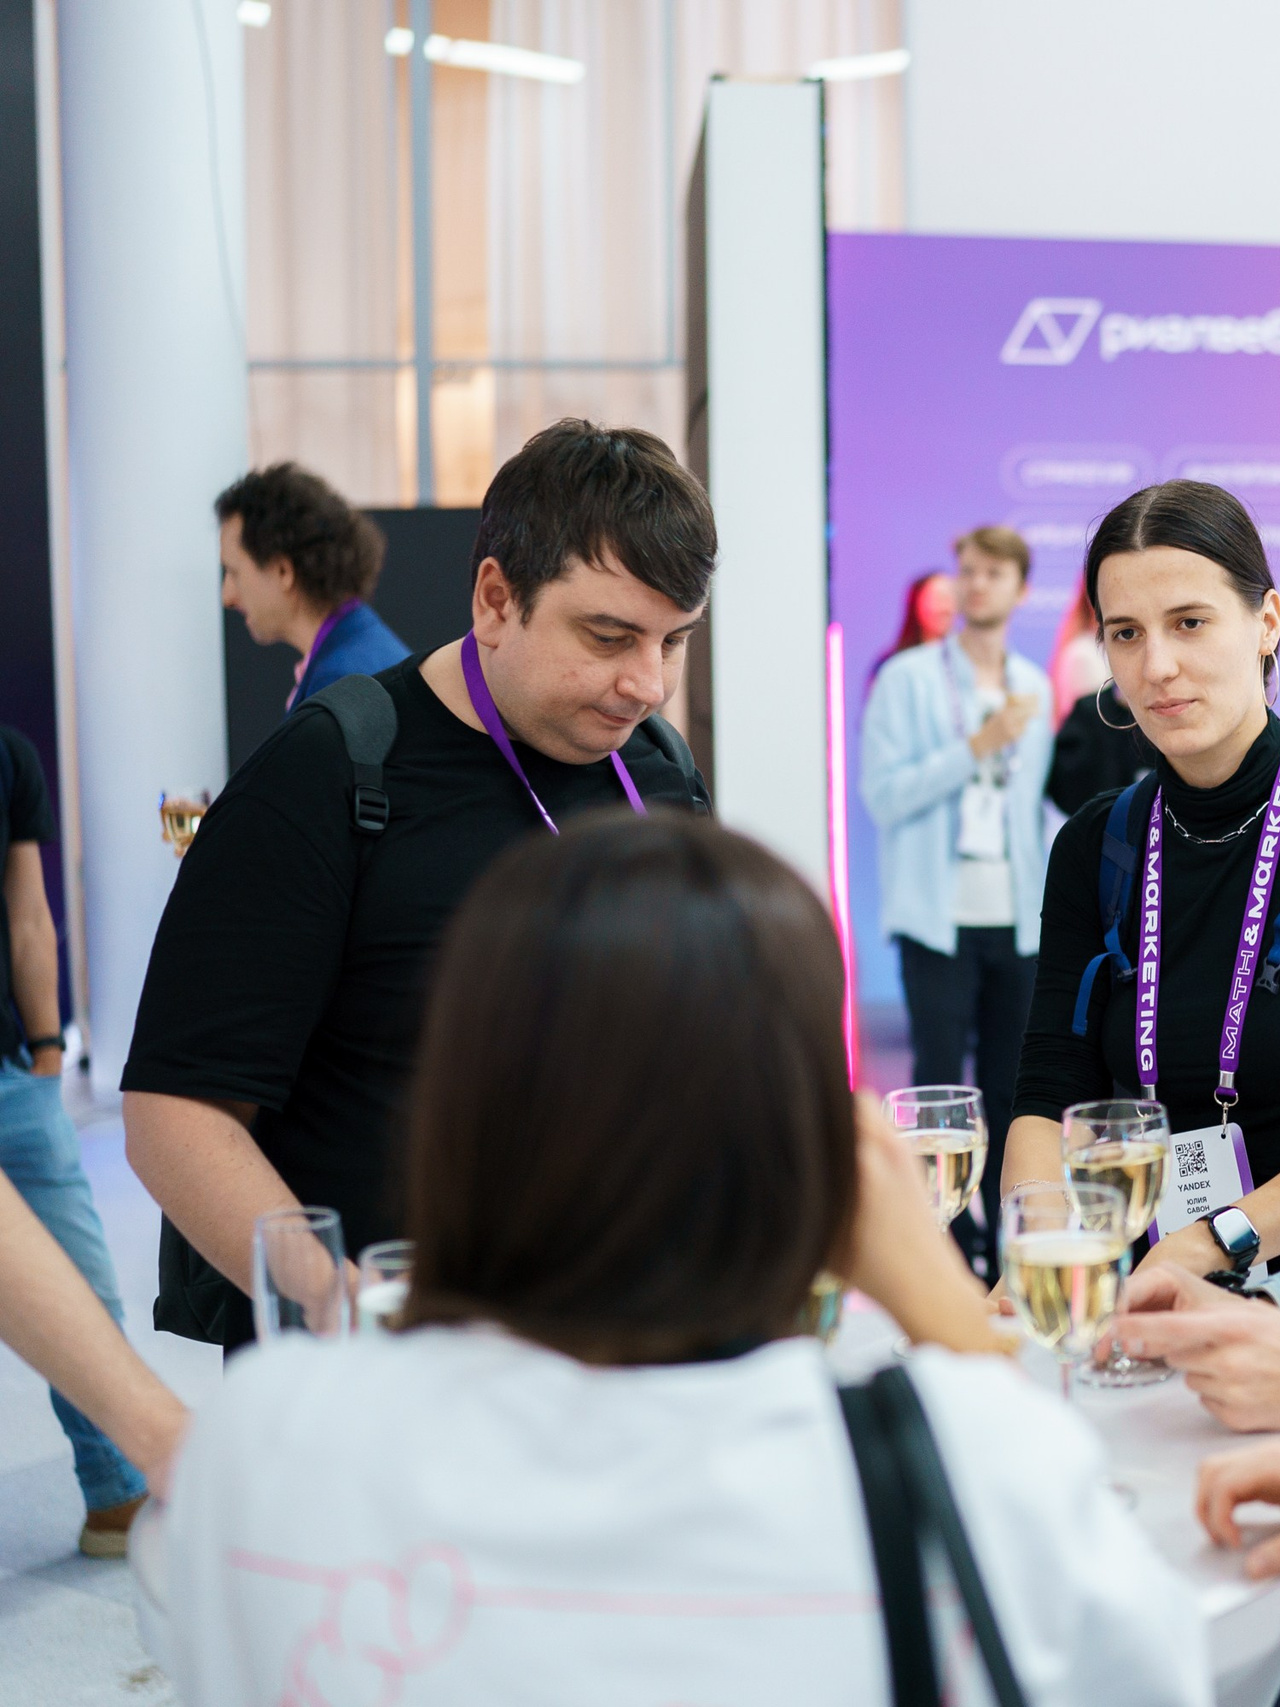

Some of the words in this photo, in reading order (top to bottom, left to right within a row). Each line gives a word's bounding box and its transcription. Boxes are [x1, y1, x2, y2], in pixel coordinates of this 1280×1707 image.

[1222, 950, 1254, 1059] MATH
[1177, 1180, 1211, 1192] YANDEX
[1186, 1196, 1207, 1206] ЮЛИЯ
[1186, 1205, 1210, 1214] САВОН
